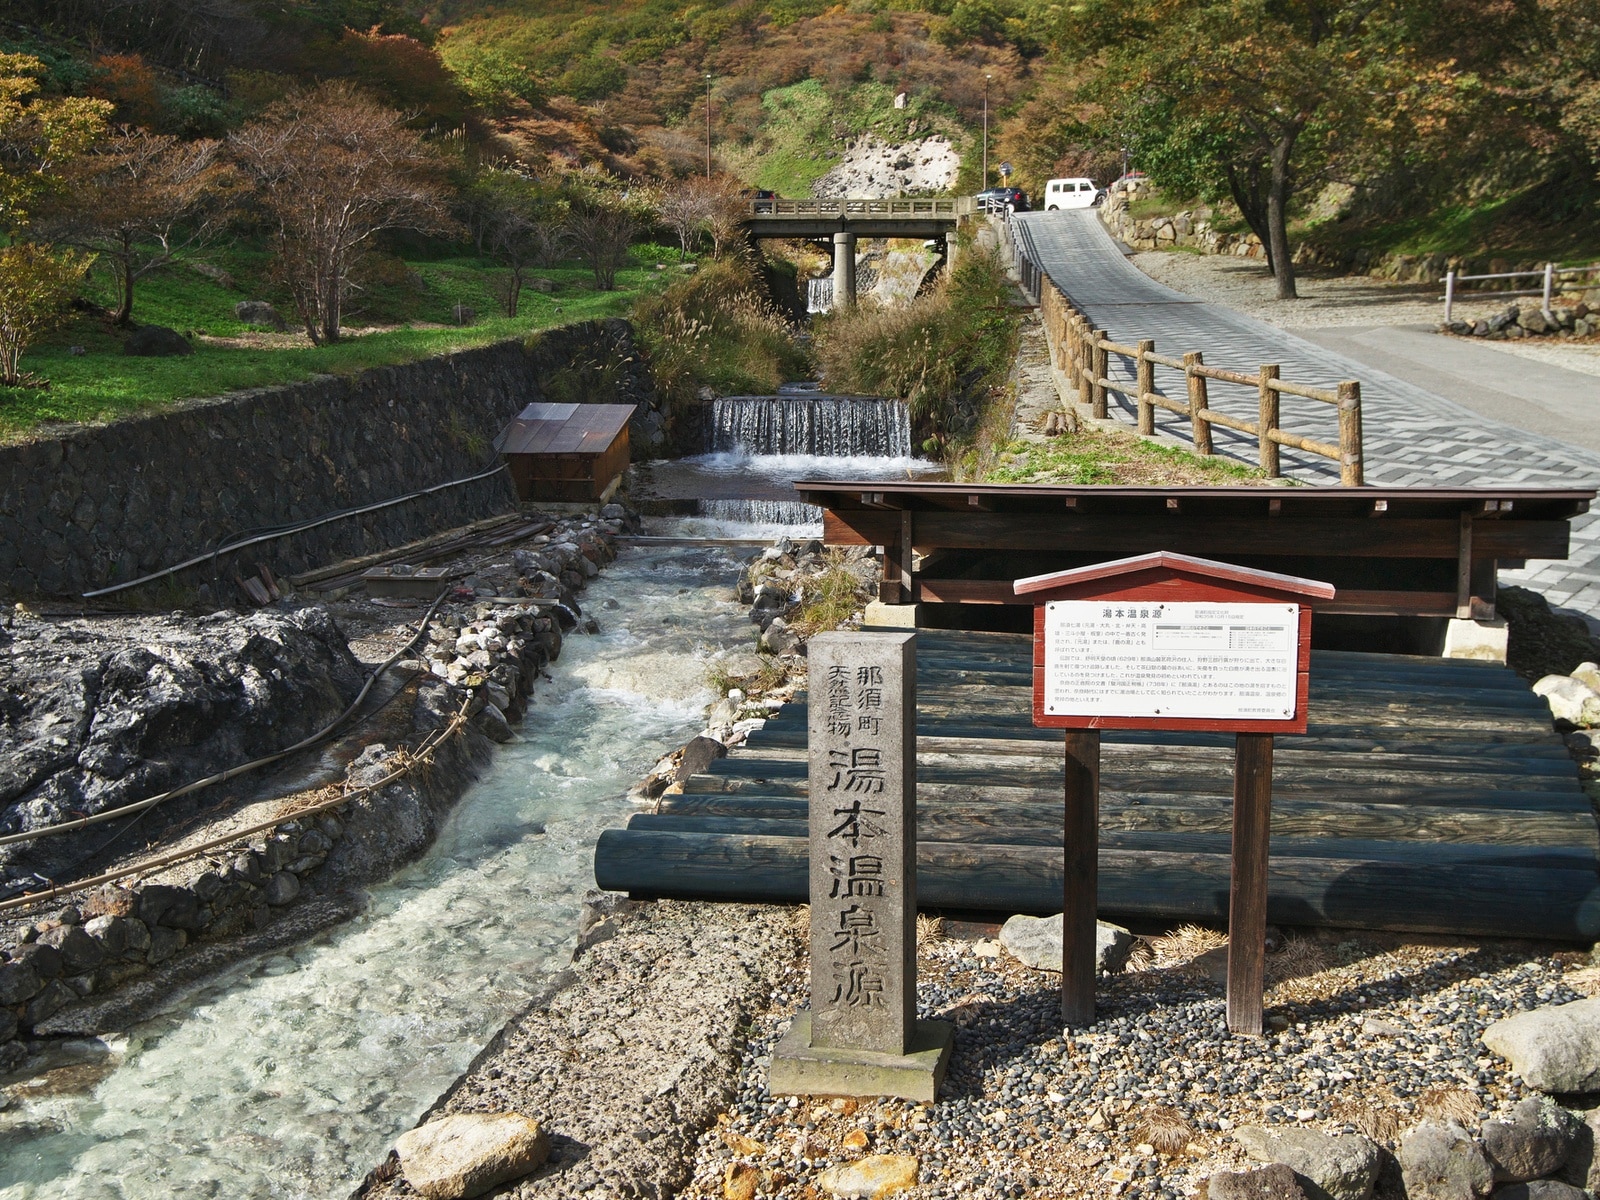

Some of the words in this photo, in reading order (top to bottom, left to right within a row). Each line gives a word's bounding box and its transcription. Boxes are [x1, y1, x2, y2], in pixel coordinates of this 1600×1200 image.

[1102, 608, 1162, 619] 湯本温泉源
[827, 665, 852, 737] 天然記念物
[857, 665, 883, 736] 那須町
[827, 746, 888, 1008] 湯本温泉源
